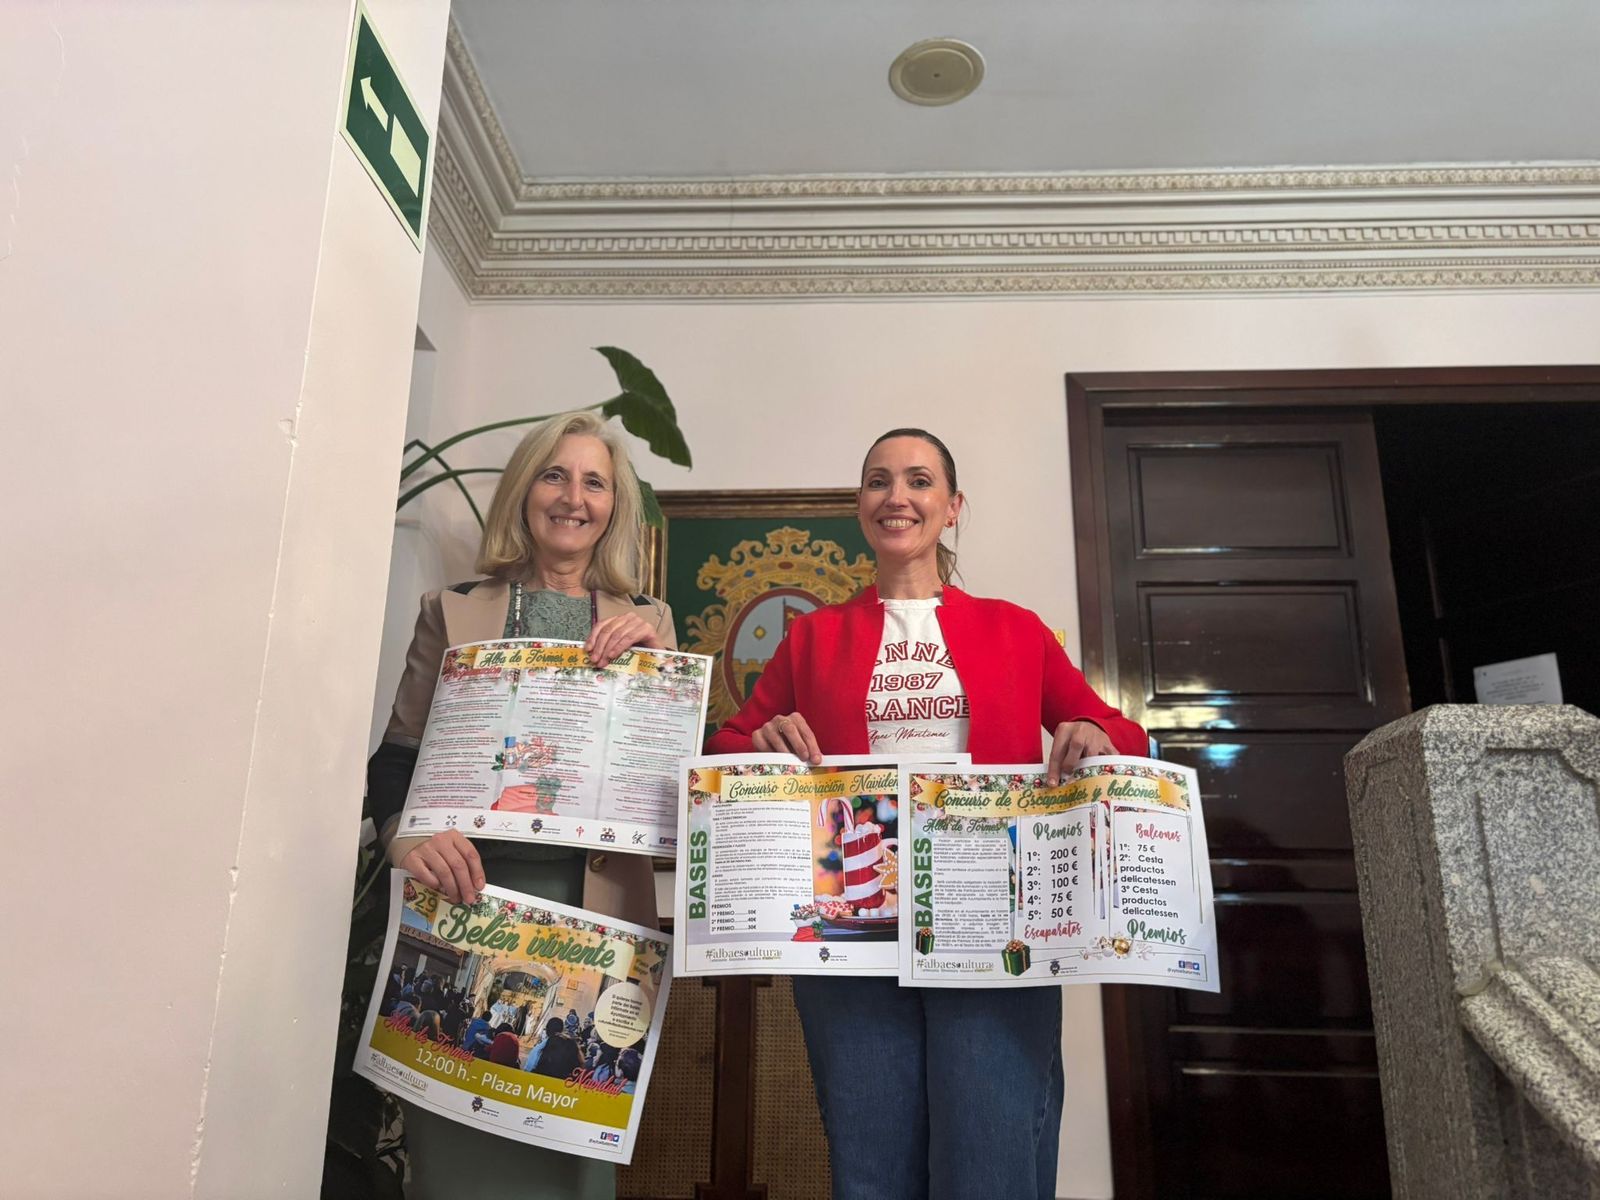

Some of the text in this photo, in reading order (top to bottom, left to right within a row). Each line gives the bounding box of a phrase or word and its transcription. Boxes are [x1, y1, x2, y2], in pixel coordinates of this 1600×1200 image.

[480, 652, 506, 667] Alba
[509, 650, 522, 663] de
[526, 650, 564, 664] Tormes
[875, 640, 955, 669] NNE
[871, 672, 943, 692] 1987
[729, 780, 779, 799] Concurso
[783, 777, 846, 796] Decoración
[934, 789, 990, 808] Concurso
[995, 790, 1012, 806] de
[1092, 786, 1102, 802] y
[1107, 779, 1161, 799] balcones
[923, 818, 1003, 834] Alba de Tormes
[1033, 821, 1084, 841] Premios
[1136, 822, 1182, 842] Balcones
[1027, 846, 1078, 862] 1º: 200 €
[1137, 844, 1148, 852] 75
[1150, 845, 1156, 853] €
[1026, 861, 1078, 876] 2º: 150 €
[1138, 854, 1164, 864] Cesta
[689, 830, 708, 920] BASES
[1120, 865, 1165, 875] productos
[914, 837, 934, 928] BASES
[1027, 875, 1078, 891] 3º: 100 €
[1120, 875, 1177, 887] delicatessen
[1132, 886, 1159, 896] Cesta
[415, 892, 438, 913] 29
[1027, 890, 1073, 906] 4º: 75 €
[1121, 897, 1167, 907] productos
[1027, 905, 1073, 921] 5º: 50 €
[1122, 907, 1179, 919] delicatessen
[438, 903, 521, 952] Belén
[526, 932, 615, 969] viviente
[1024, 920, 1083, 942] Escaparates
[1127, 918, 1187, 945] Premios
[383, 1010, 475, 1063] Alba de Tormes
[415, 1048, 455, 1075] 12:00
[481, 1072, 522, 1097] Plaza
[526, 1084, 579, 1110] Mayor
[564, 1067, 629, 1097] Navidad
